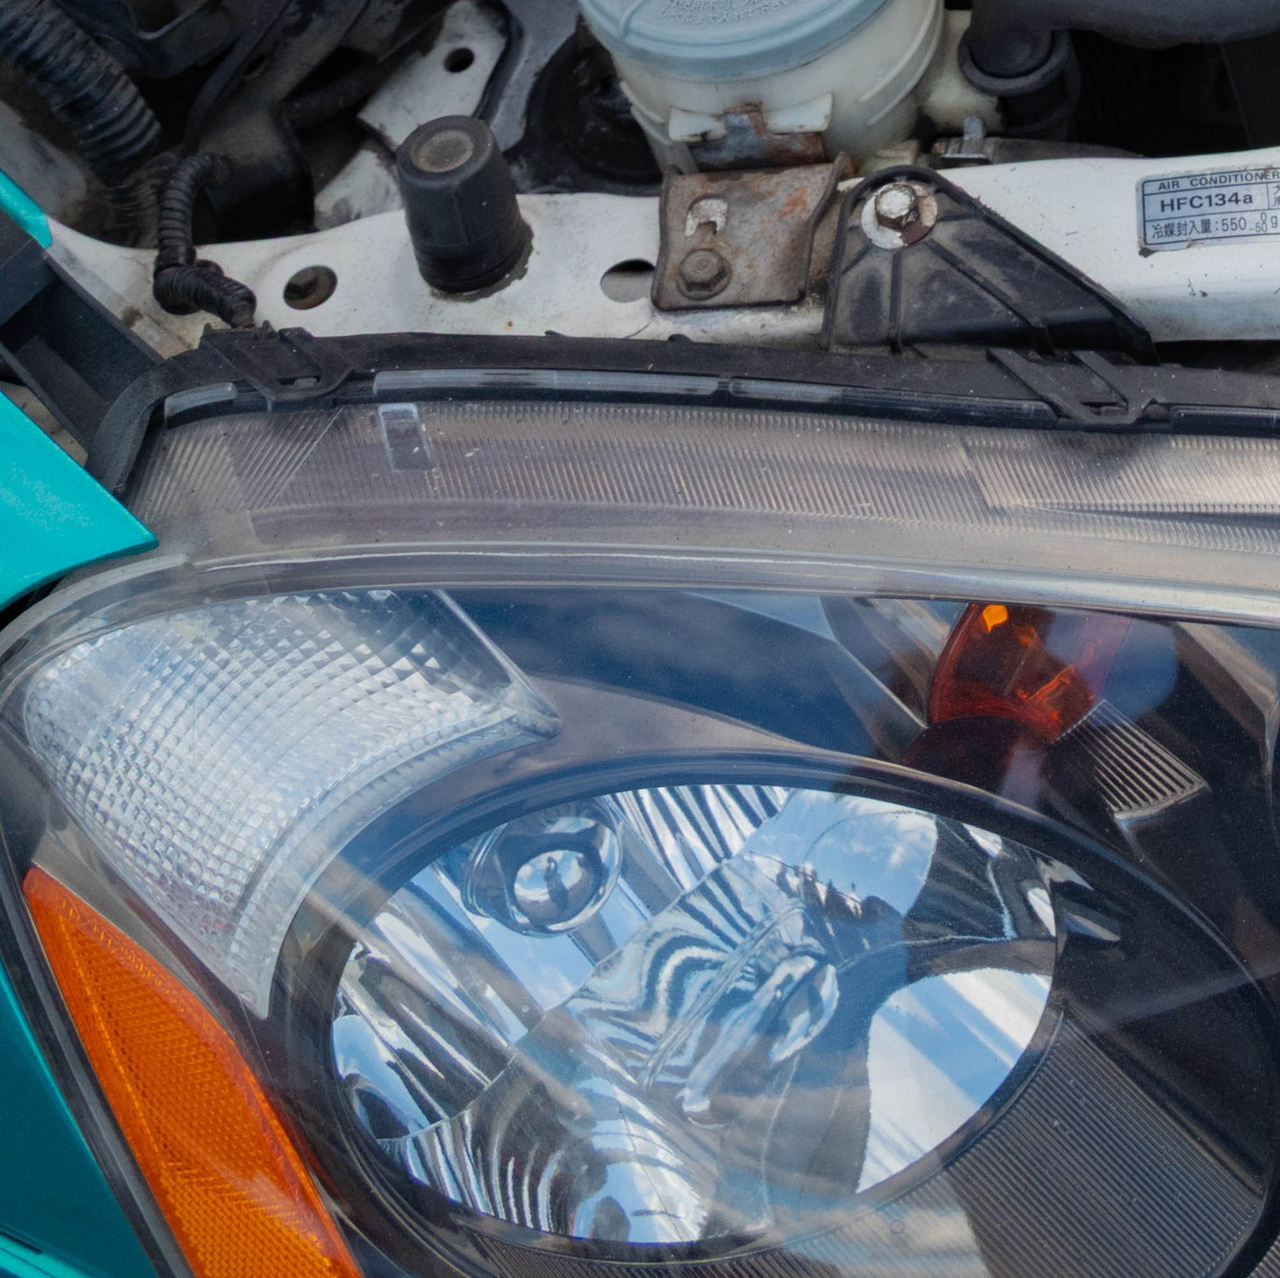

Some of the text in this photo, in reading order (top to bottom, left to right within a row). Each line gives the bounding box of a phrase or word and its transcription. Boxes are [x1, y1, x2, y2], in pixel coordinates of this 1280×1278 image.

[1158, 180, 1180, 191] AIR
[1190, 170, 1280, 187] CONDITIONER
[1160, 192, 1253, 213] HFC134a
